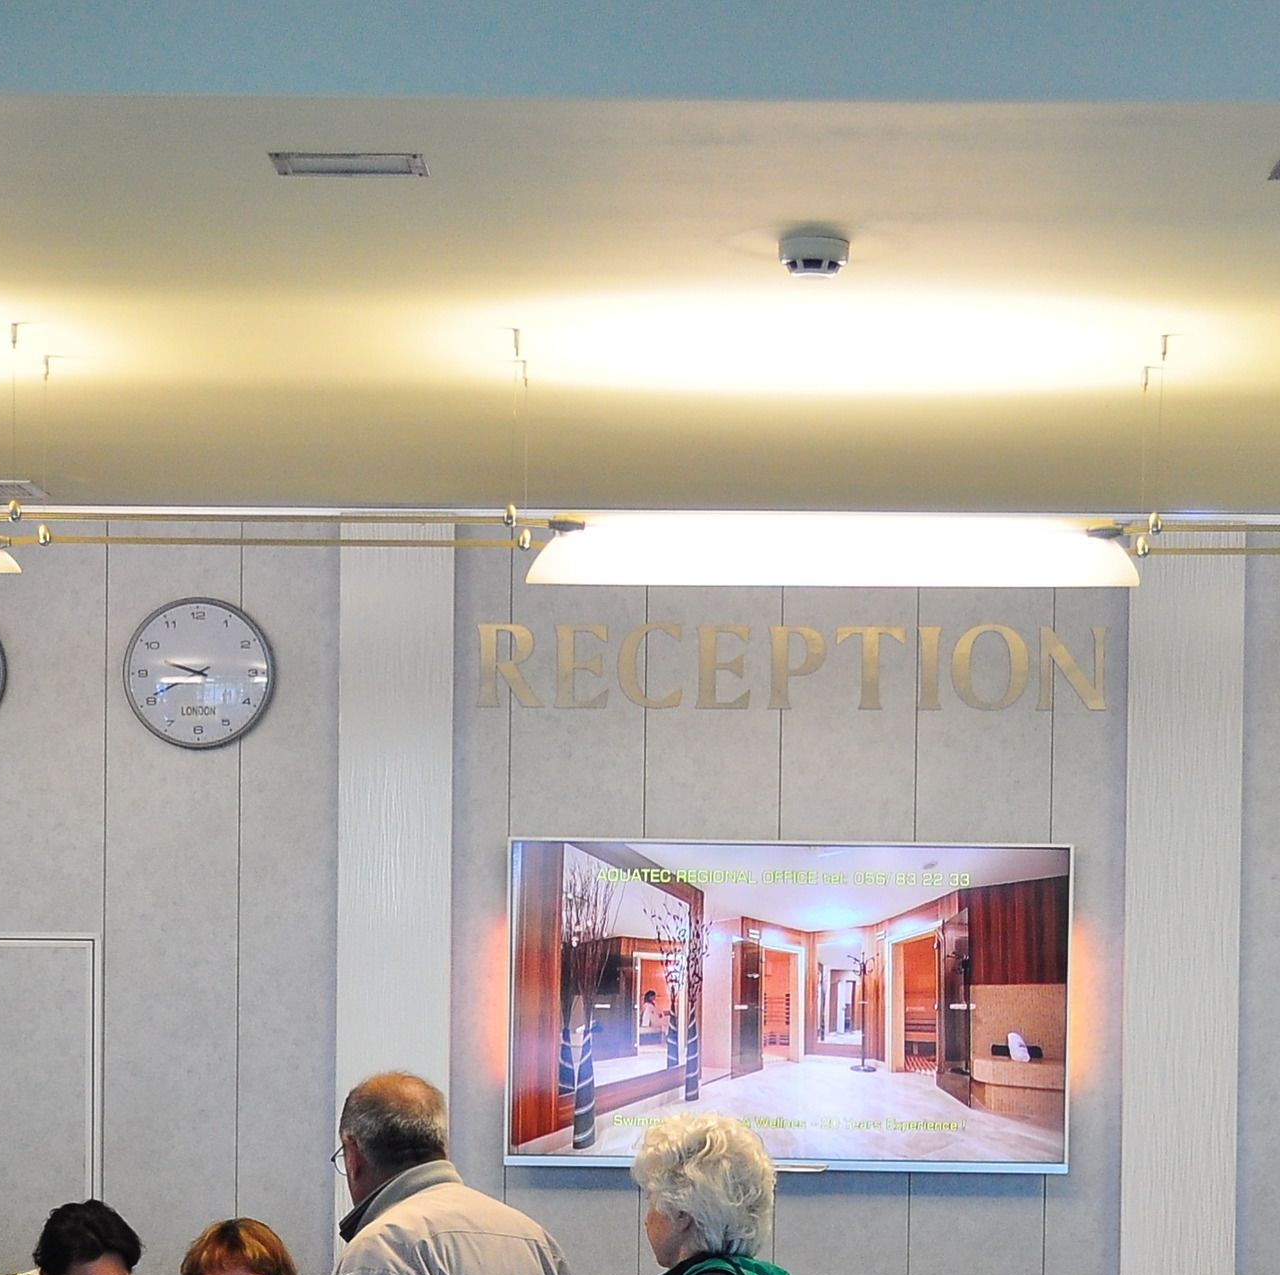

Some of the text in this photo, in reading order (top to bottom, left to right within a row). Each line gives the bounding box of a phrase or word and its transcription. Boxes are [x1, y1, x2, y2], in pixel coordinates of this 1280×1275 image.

[191, 611, 206, 620] 12
[224, 620, 228, 628] 1
[145, 641, 160, 649] 10
[241, 640, 251, 649] 2
[475, 621, 1108, 711] RECEPTION
[138, 669, 148, 678] 9
[248, 669, 258, 677] 3
[146, 697, 157, 706] 8
[181, 706, 216, 716] LONDON
[193, 725, 203, 734] 6
[596, 869, 672, 884] AQUATEC
[676, 869, 757, 884] REGIONAL
[762, 871, 817, 885] OFFICE
[922, 873, 944, 887] 22
[949, 873, 971, 888] 33
